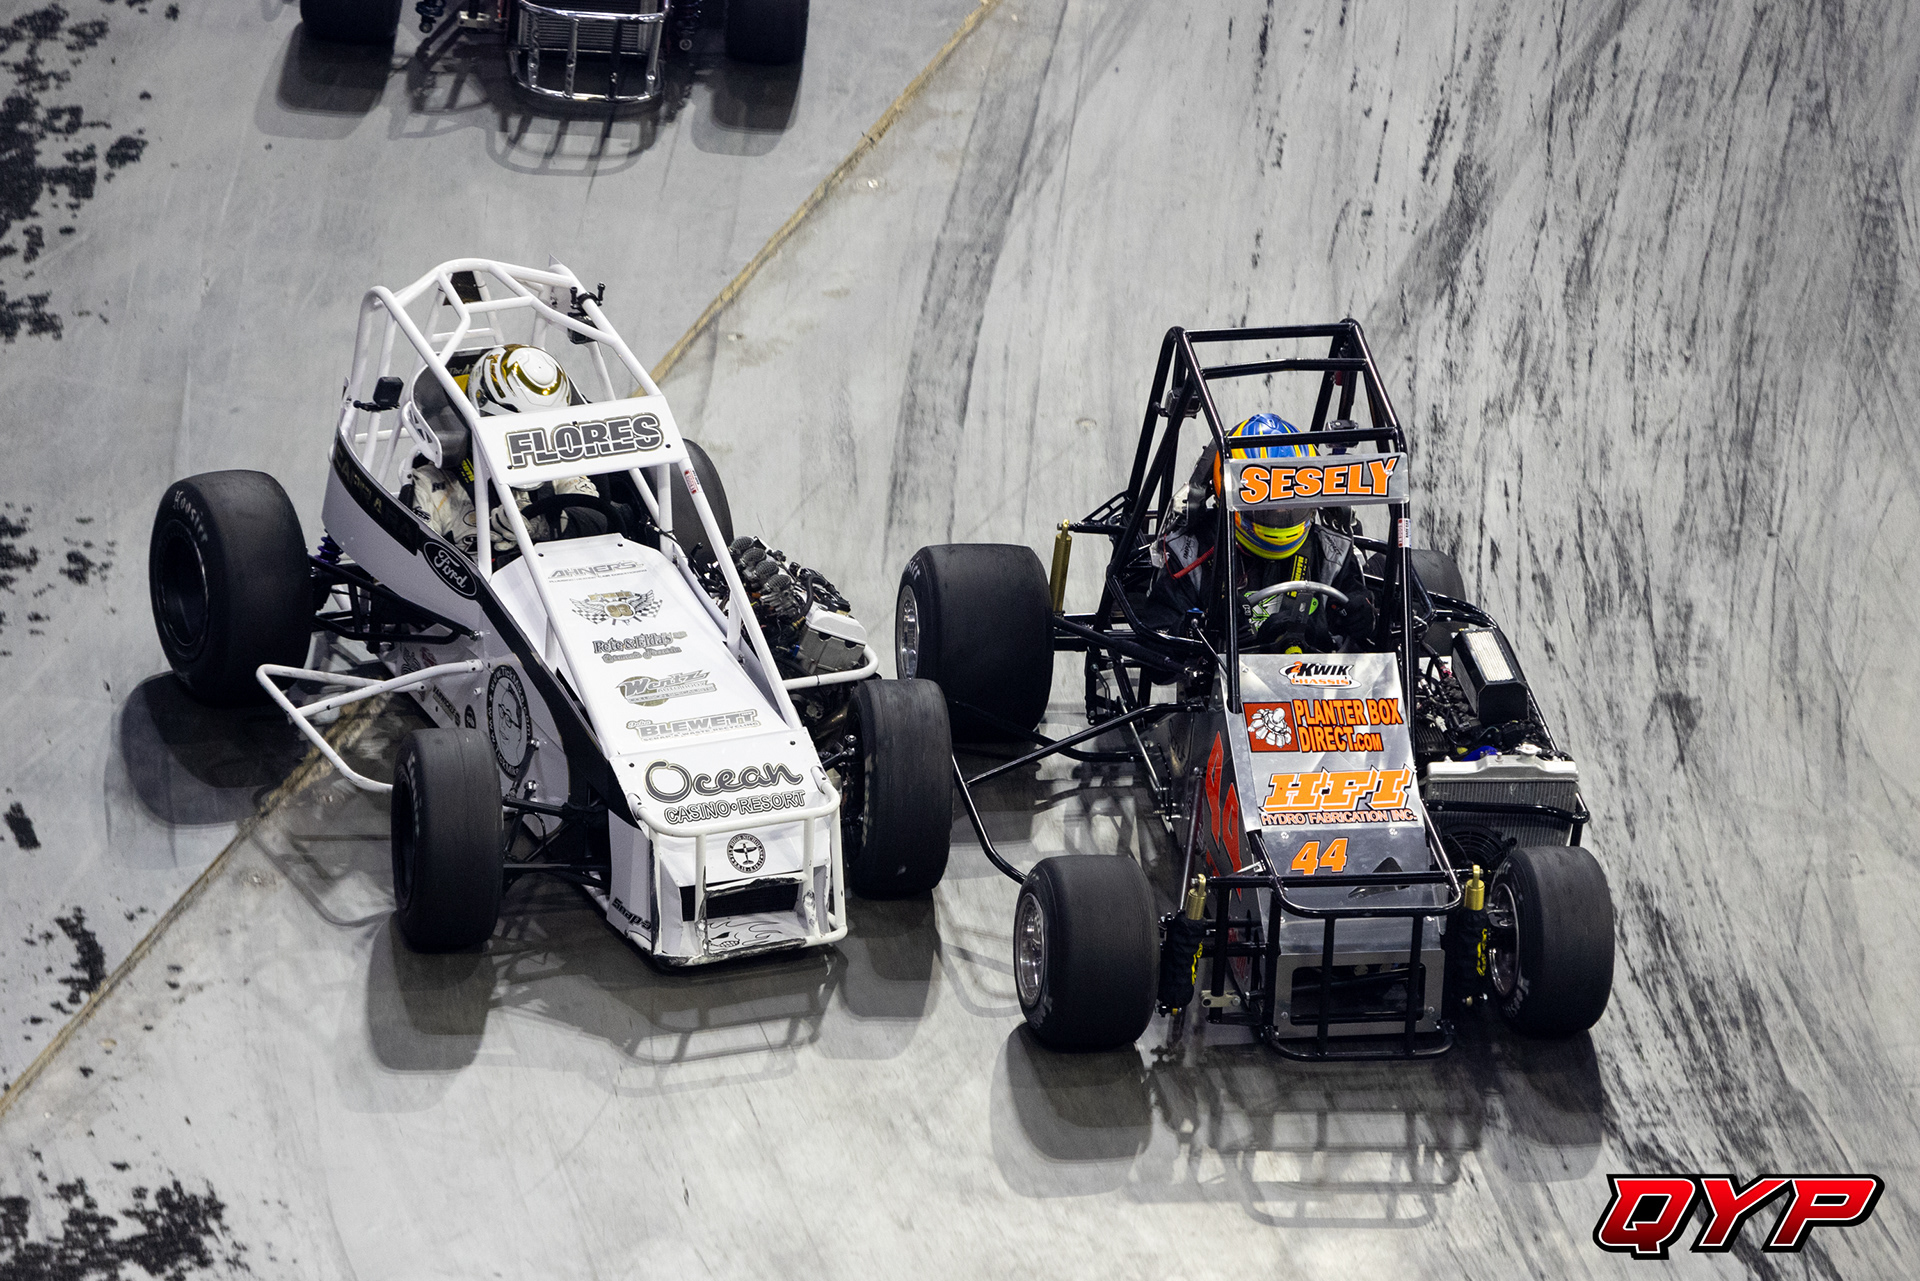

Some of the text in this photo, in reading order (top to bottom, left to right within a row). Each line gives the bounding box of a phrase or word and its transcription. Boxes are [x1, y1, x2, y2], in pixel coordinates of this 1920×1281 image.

[506, 412, 663, 468] FLORES
[1238, 456, 1402, 504] SESELY
[433, 550, 467, 588] Ford
[549, 561, 642, 578] AHNER'S
[606, 603, 635, 617] 93
[624, 670, 711, 697] Wentz
[1290, 678, 1350, 686] CHASSIS
[640, 711, 755, 737] BLEWETT
[1292, 698, 1404, 726] PLANTER BOX
[1297, 726, 1385, 753] DIRECT.COM
[644, 760, 803, 803] Ocean
[1259, 764, 1415, 813] HFI
[664, 790, 806, 824] CASINO RESORT
[1261, 809, 1418, 826] HYDRO FABRICATION INC.
[1290, 837, 1349, 876] 44
